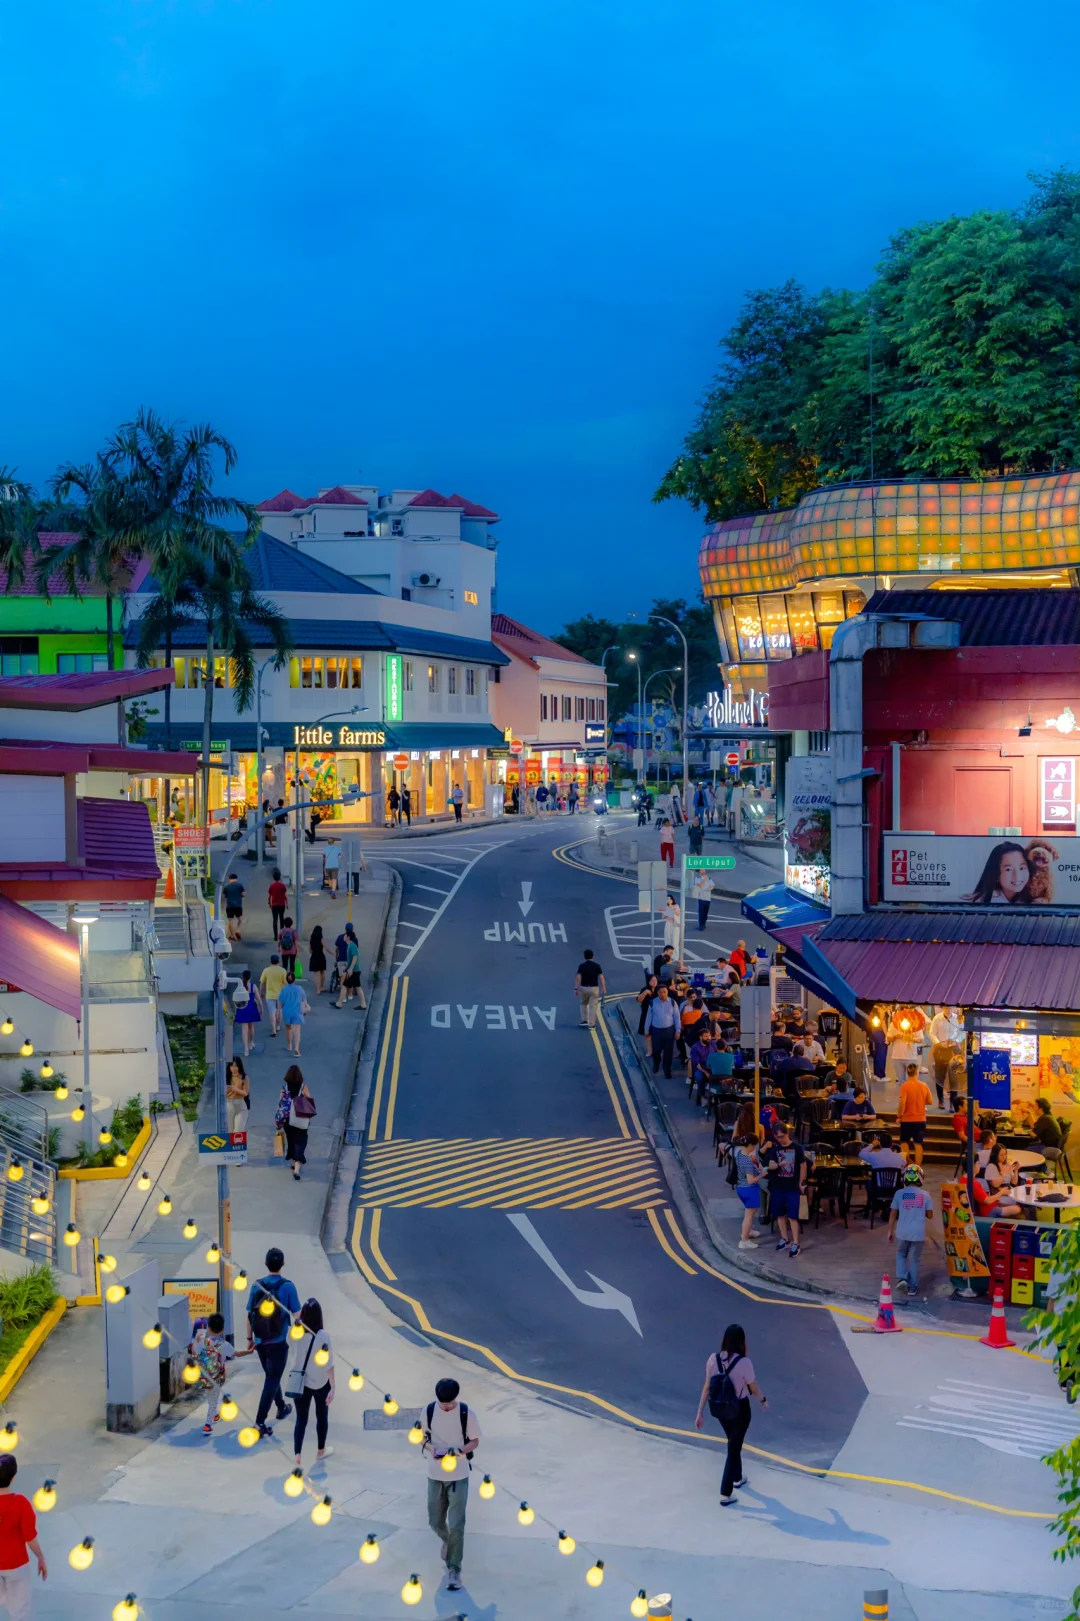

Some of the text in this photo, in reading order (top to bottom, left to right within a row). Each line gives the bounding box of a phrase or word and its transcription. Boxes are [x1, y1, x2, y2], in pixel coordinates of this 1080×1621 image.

[294, 726, 386, 745] little farms
[196, 742, 226, 750] Mbong
[909, 850, 928, 861] Pet
[688, 857, 731, 868] Lor Liput
[909, 861, 947, 871] Lovers
[909, 871, 947, 881] Centre
[484, 921, 568, 944] HUMP
[430, 1004, 557, 1031] AHEAD
[983, 1072, 1007, 1084] Tiger
[188, 1291, 215, 1305] Open
